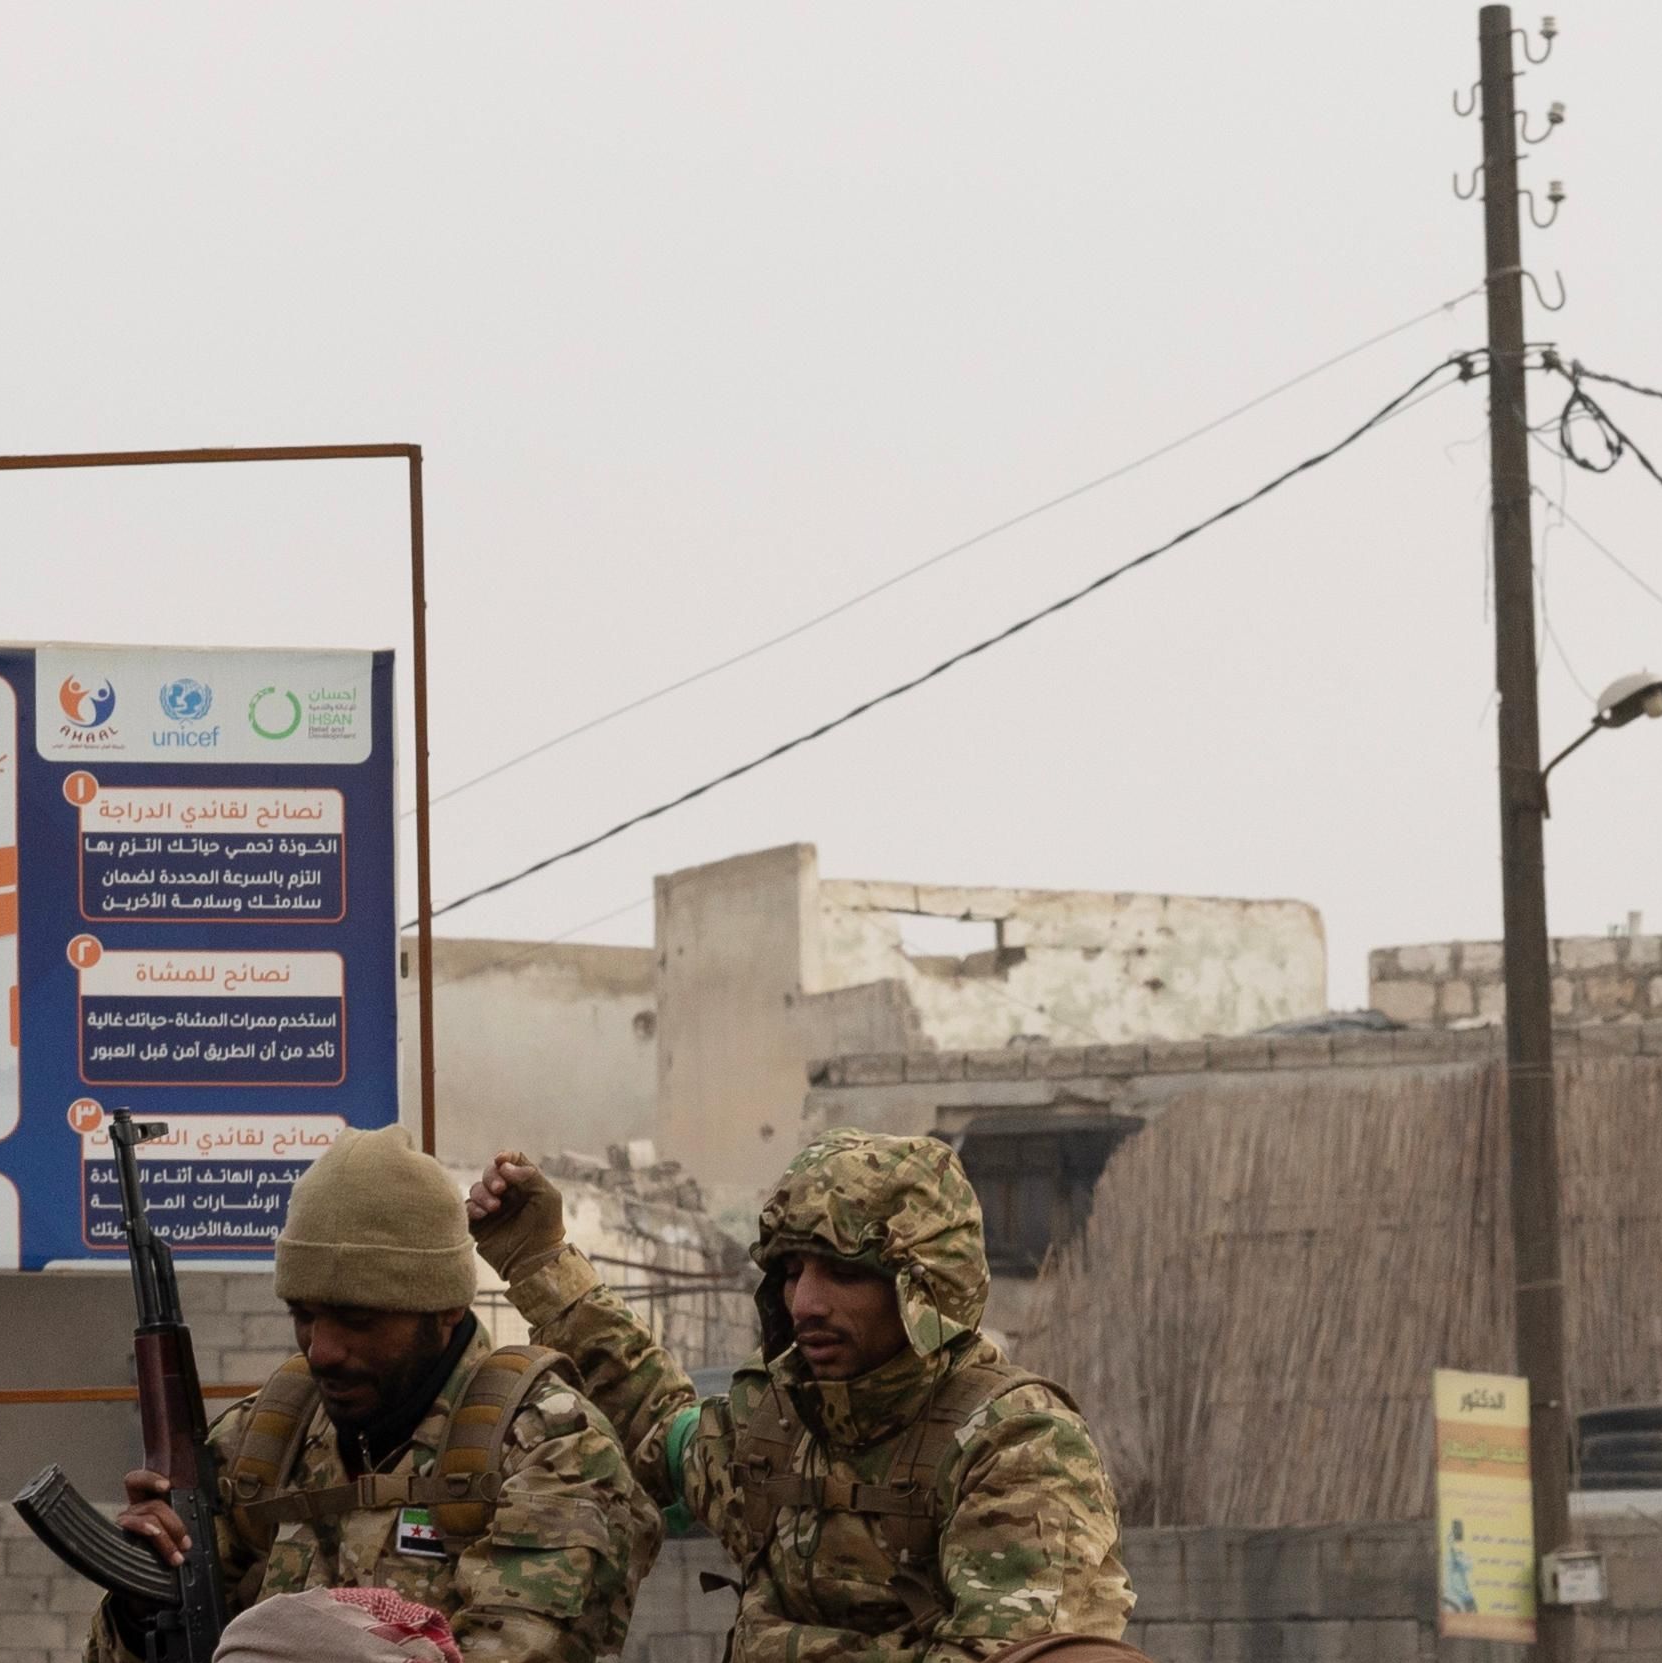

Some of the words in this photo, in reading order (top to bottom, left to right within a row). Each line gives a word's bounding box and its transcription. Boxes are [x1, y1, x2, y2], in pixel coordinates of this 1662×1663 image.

[309, 713, 353, 726] IHSAN
[152, 725, 220, 747] unicef
[99, 800, 171, 824] الدراجة
[180, 800, 248, 828] لقائدي
[257, 800, 323, 827] نصائح
[84, 838, 115, 856] بها
[119, 838, 162, 858] التزم
[167, 838, 220, 856] حياتك
[225, 838, 273, 859] تحمي
[279, 838, 337, 856] الخوذة
[102, 869, 155, 887] لضمان
[159, 869, 219, 885] المحددة
[223, 869, 283, 887] بالسرعة
[287, 869, 321, 889] التزم
[171, 893, 243, 912] وسلامة
[247, 893, 321, 910] سلامتك
[136, 961, 215, 983] للمشاة
[224, 963, 290, 991] نصائح
[87, 1012, 124, 1030] غالية
[230, 1012, 278, 1030] ممرات
[278, 1012, 336, 1031] استخدم
[90, 1043, 135, 1061] العبور
[140, 1043, 168, 1060] قبل
[172, 1041, 200, 1060] آمن
[203, 1043, 255, 1060] الطريق
[259, 1041, 276, 1060] أن
[280, 1044, 303, 1060] من
[306, 1041, 335, 1059] تأكد
[196, 1129, 264, 1156] لقائدي
[153, 1165, 192, 1183] أثناء
[196, 1166, 253, 1183] الهاتف
[192, 1193, 280, 1213] الإشارات
[222, 1221, 278, 1240] وسلامة
